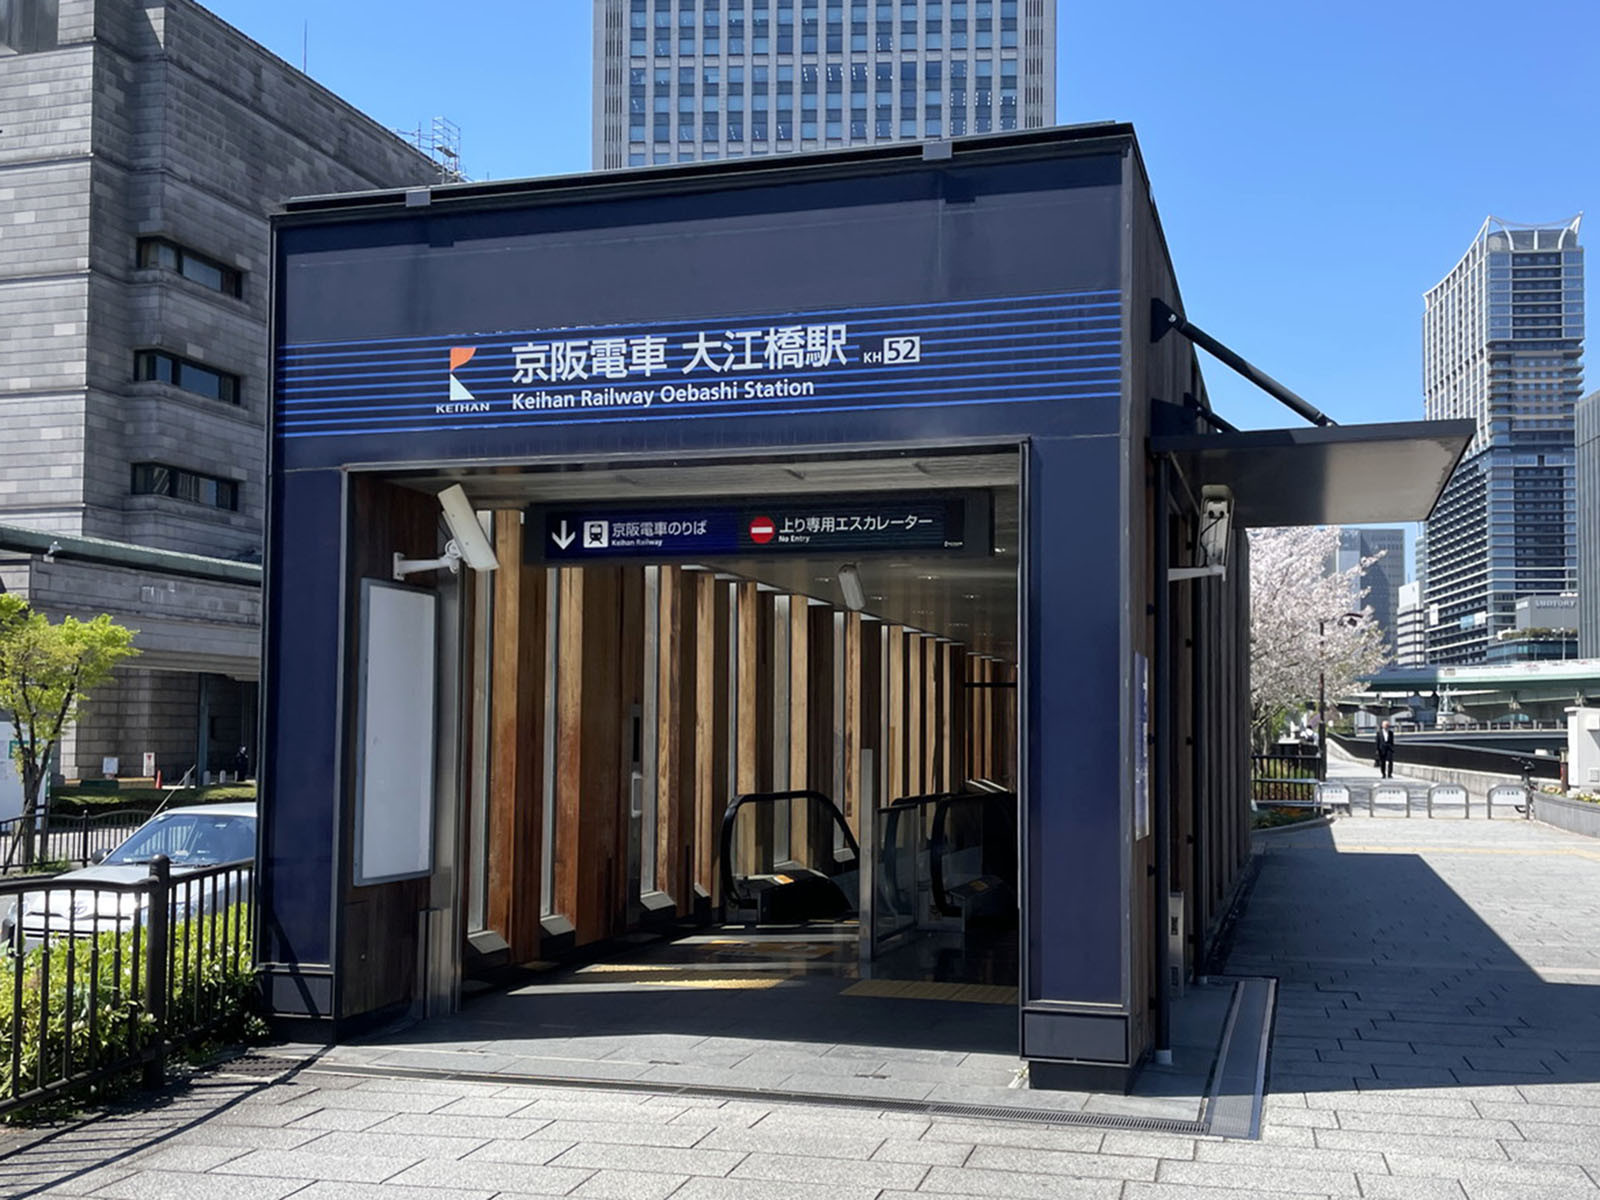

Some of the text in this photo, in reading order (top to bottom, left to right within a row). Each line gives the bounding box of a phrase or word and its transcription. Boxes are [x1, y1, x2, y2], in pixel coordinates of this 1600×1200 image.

[511, 324, 848, 384] 京阪電車 大江橋駅
[863, 339, 917, 364] KH 52
[512, 378, 815, 411] Keihan Railway Oebashi Station
[435, 403, 490, 414] KEIHAN
[611, 520, 708, 537] 京阪電車のりば
[779, 515, 933, 533] 上り専用エスカレーター
[611, 538, 635, 546] Keihan
[778, 535, 810, 543] No Entry
